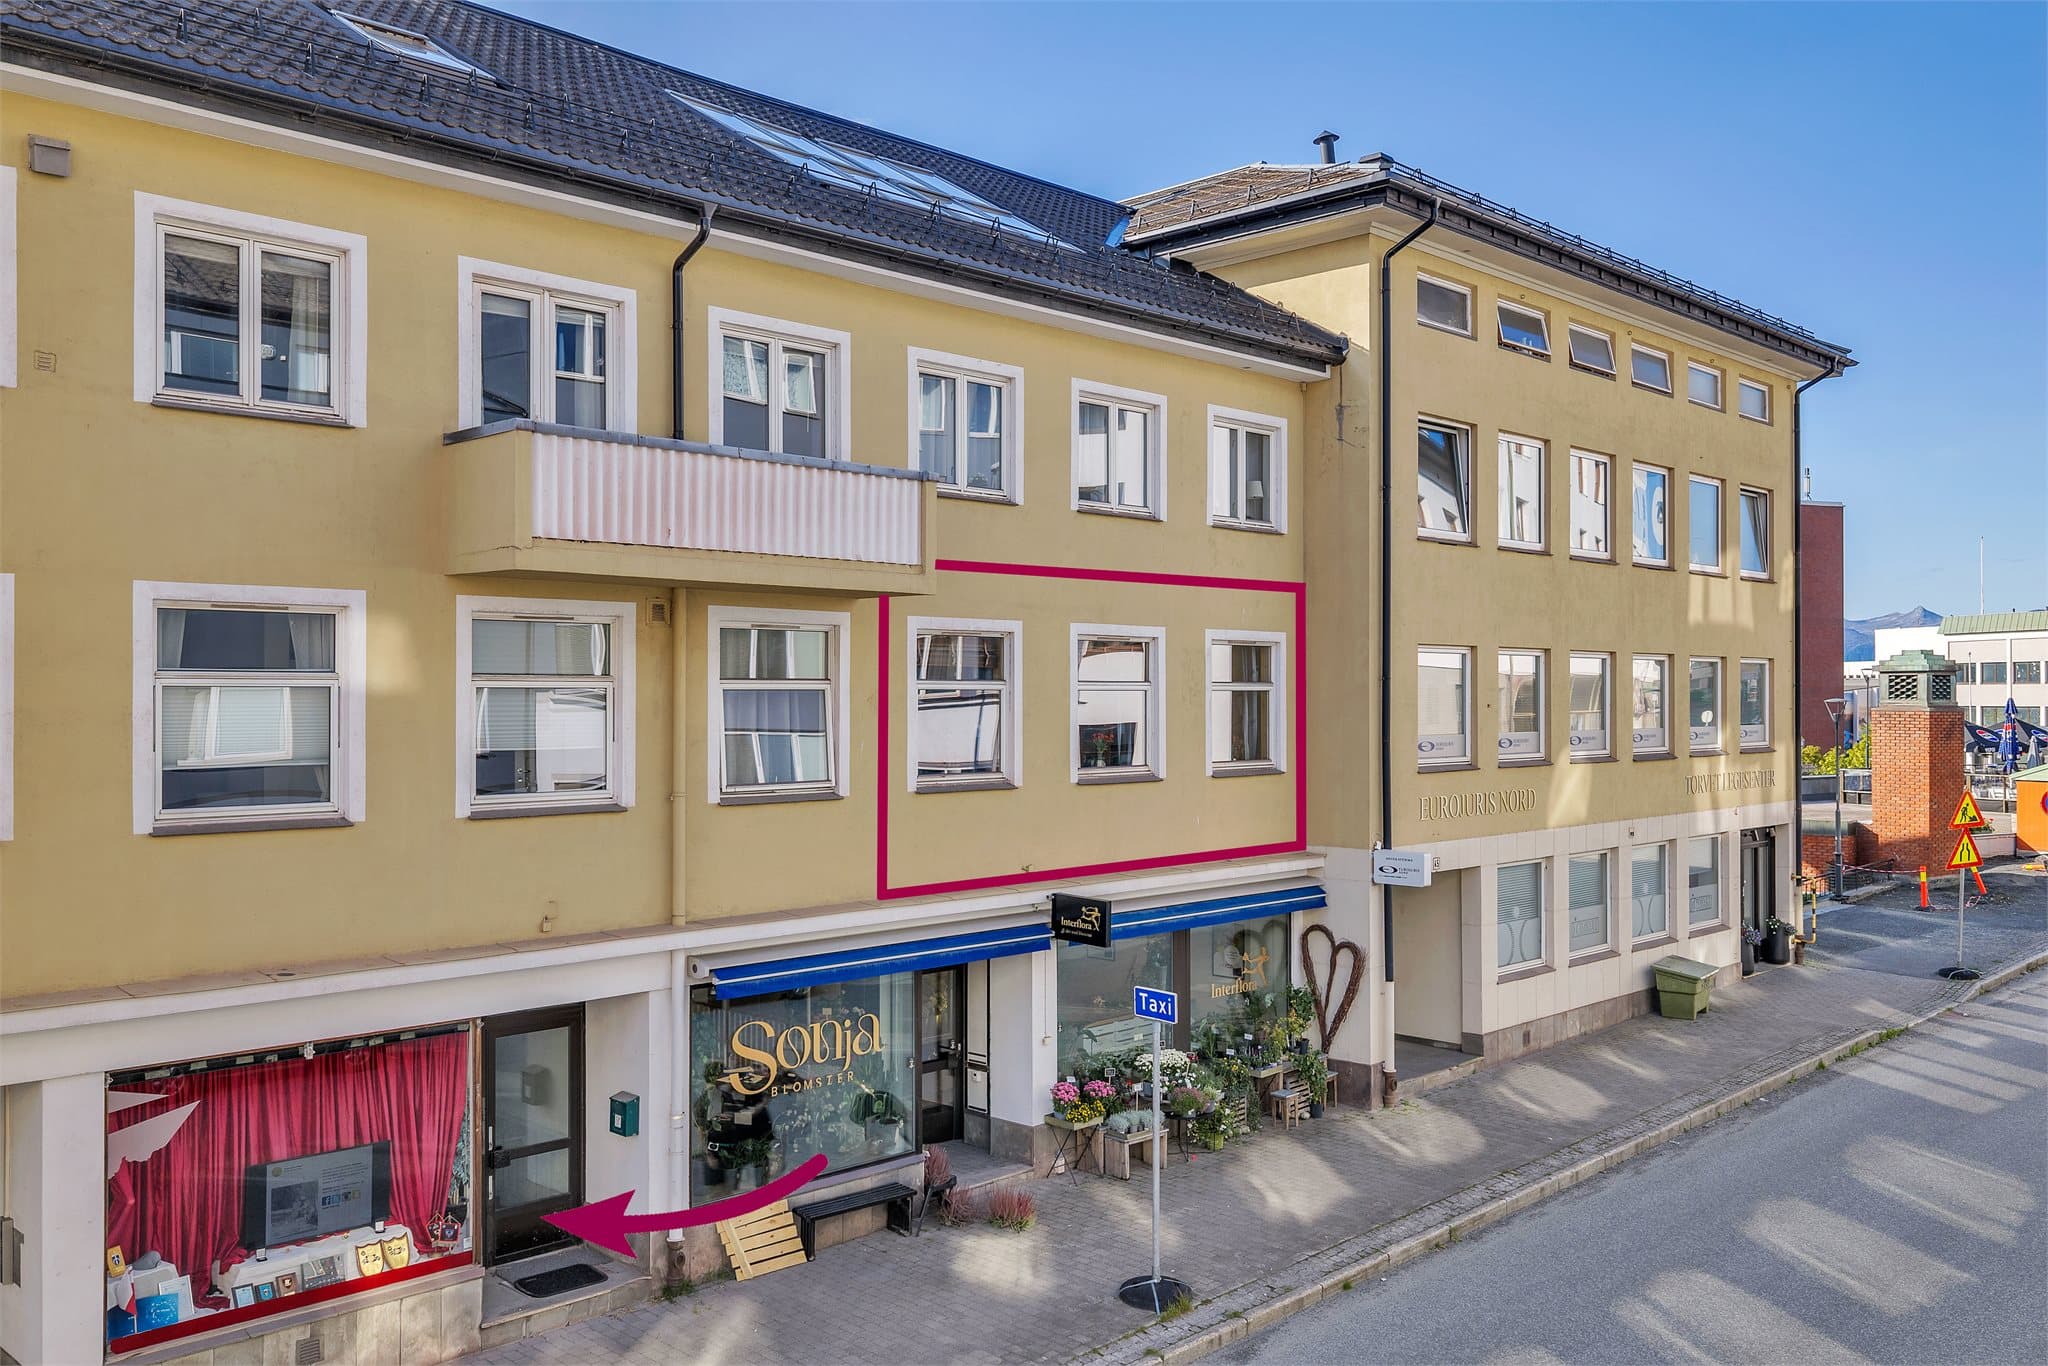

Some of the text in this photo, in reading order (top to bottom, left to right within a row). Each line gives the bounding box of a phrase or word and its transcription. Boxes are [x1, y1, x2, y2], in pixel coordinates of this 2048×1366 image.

[1685, 767, 1776, 795] TORVET LEGESENTER
[1419, 788, 1537, 820] EUROJURIS NORD
[1061, 915, 1093, 930] Interflora
[1211, 977, 1257, 999] Interflora
[1139, 992, 1172, 1016] Taxi
[729, 1013, 884, 1095] Sonja
[770, 1071, 854, 1097] BLOMSTER
